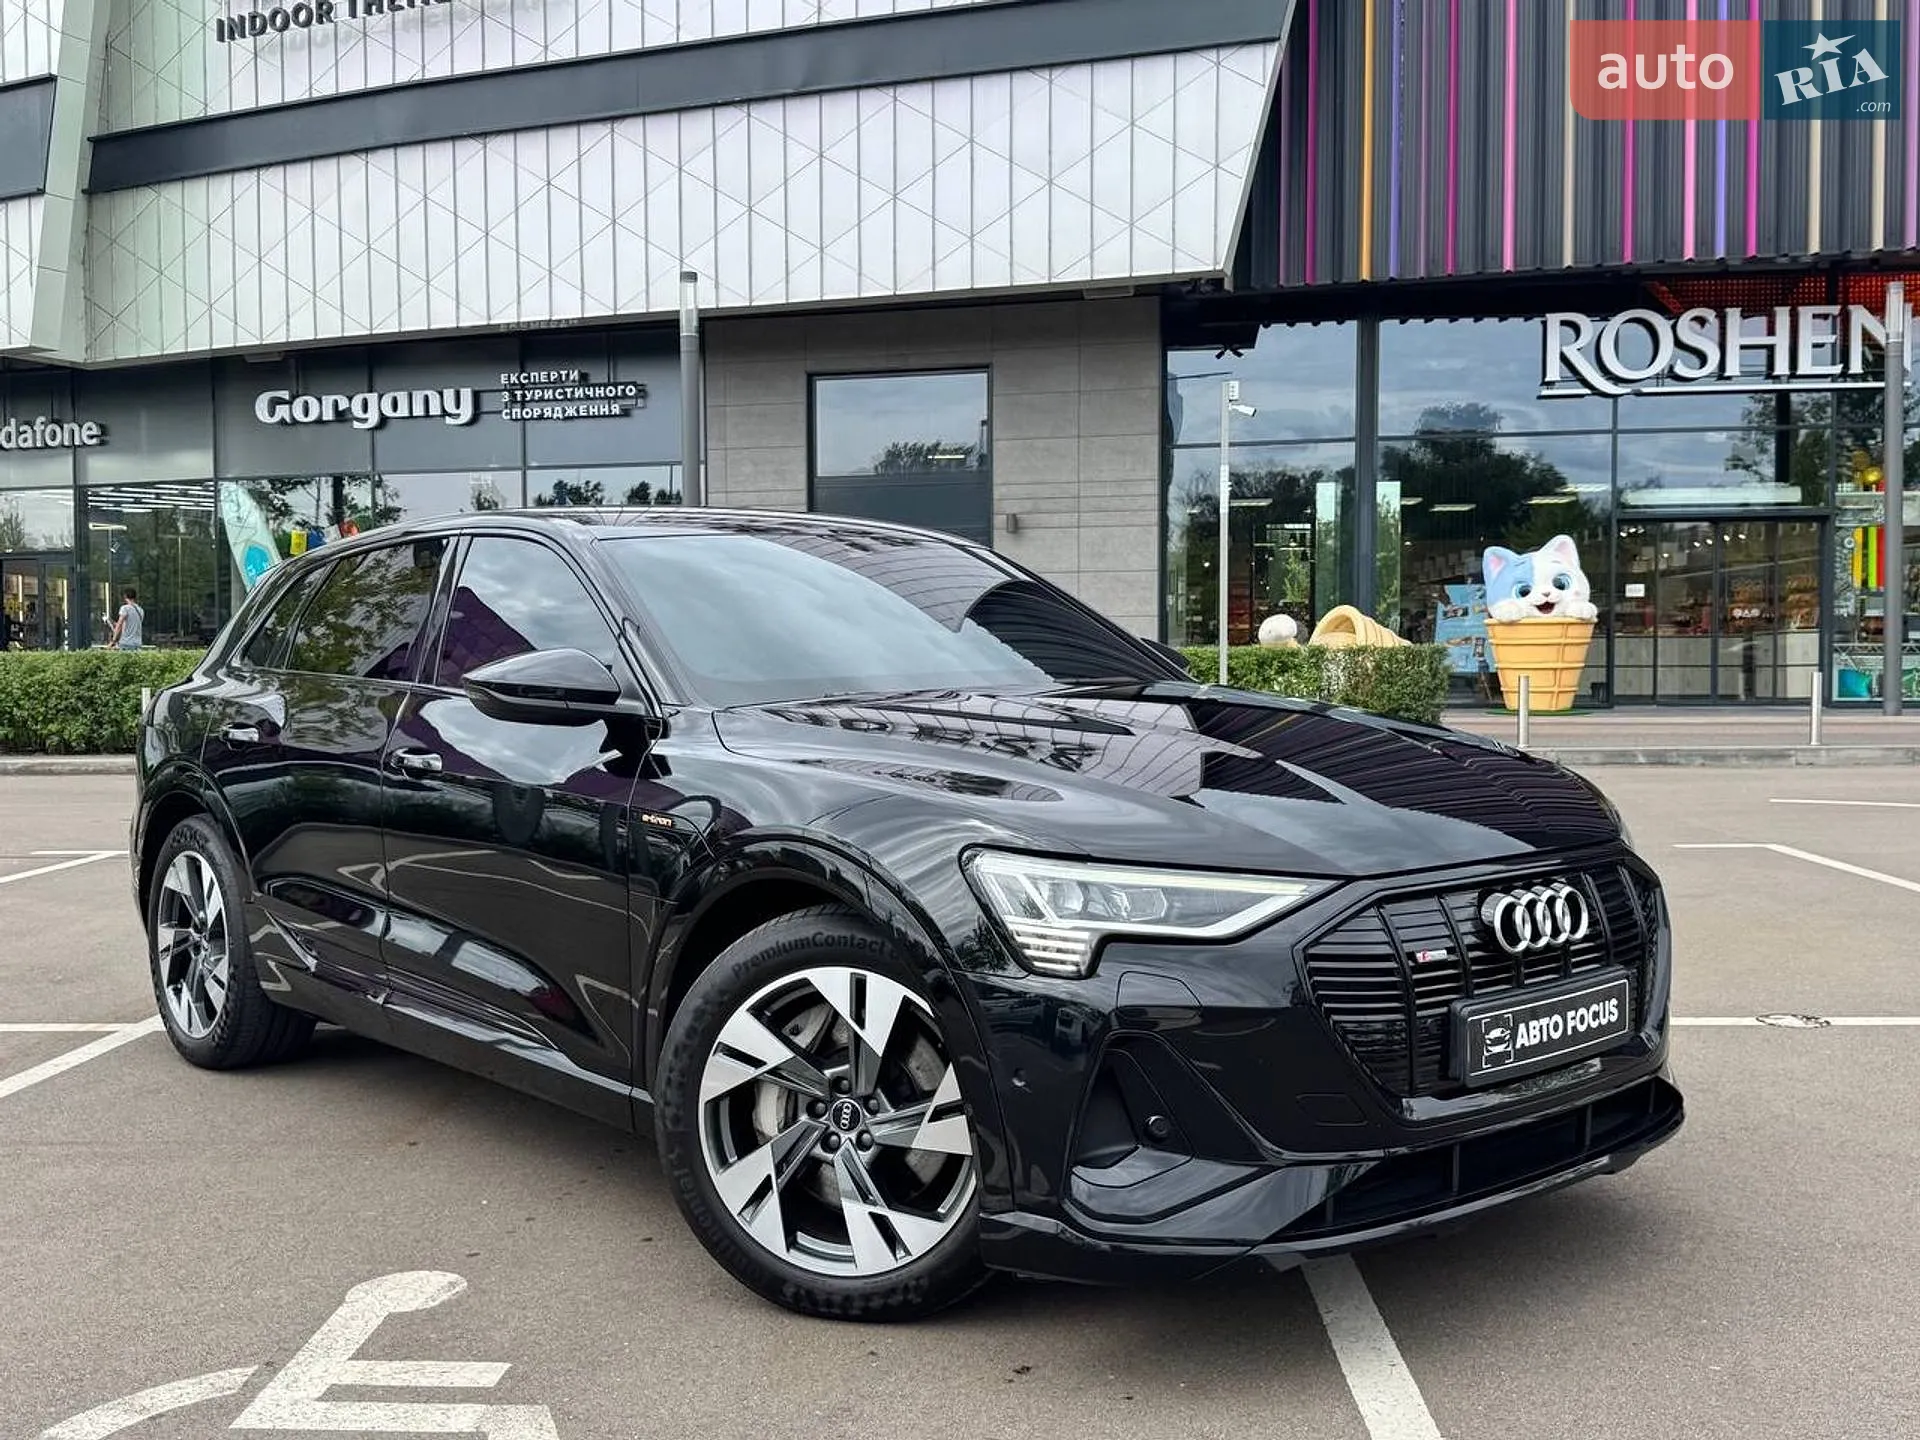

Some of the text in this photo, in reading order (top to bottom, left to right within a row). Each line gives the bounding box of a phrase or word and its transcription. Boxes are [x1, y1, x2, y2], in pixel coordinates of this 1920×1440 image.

[216, 0, 334, 42] INDOOR
[1543, 304, 1912, 394] ROSHEN
[501, 369, 580, 385] ЕКСПЕРТИ
[514, 385, 637, 402] ТУРИСТИЧНОГО
[254, 387, 475, 430] Gorgany
[502, 403, 621, 420] СПОРЯДЖЕННЯ
[731, 931, 887, 979] PremiumContact
[1566, 997, 1620, 1036] FOCUS
